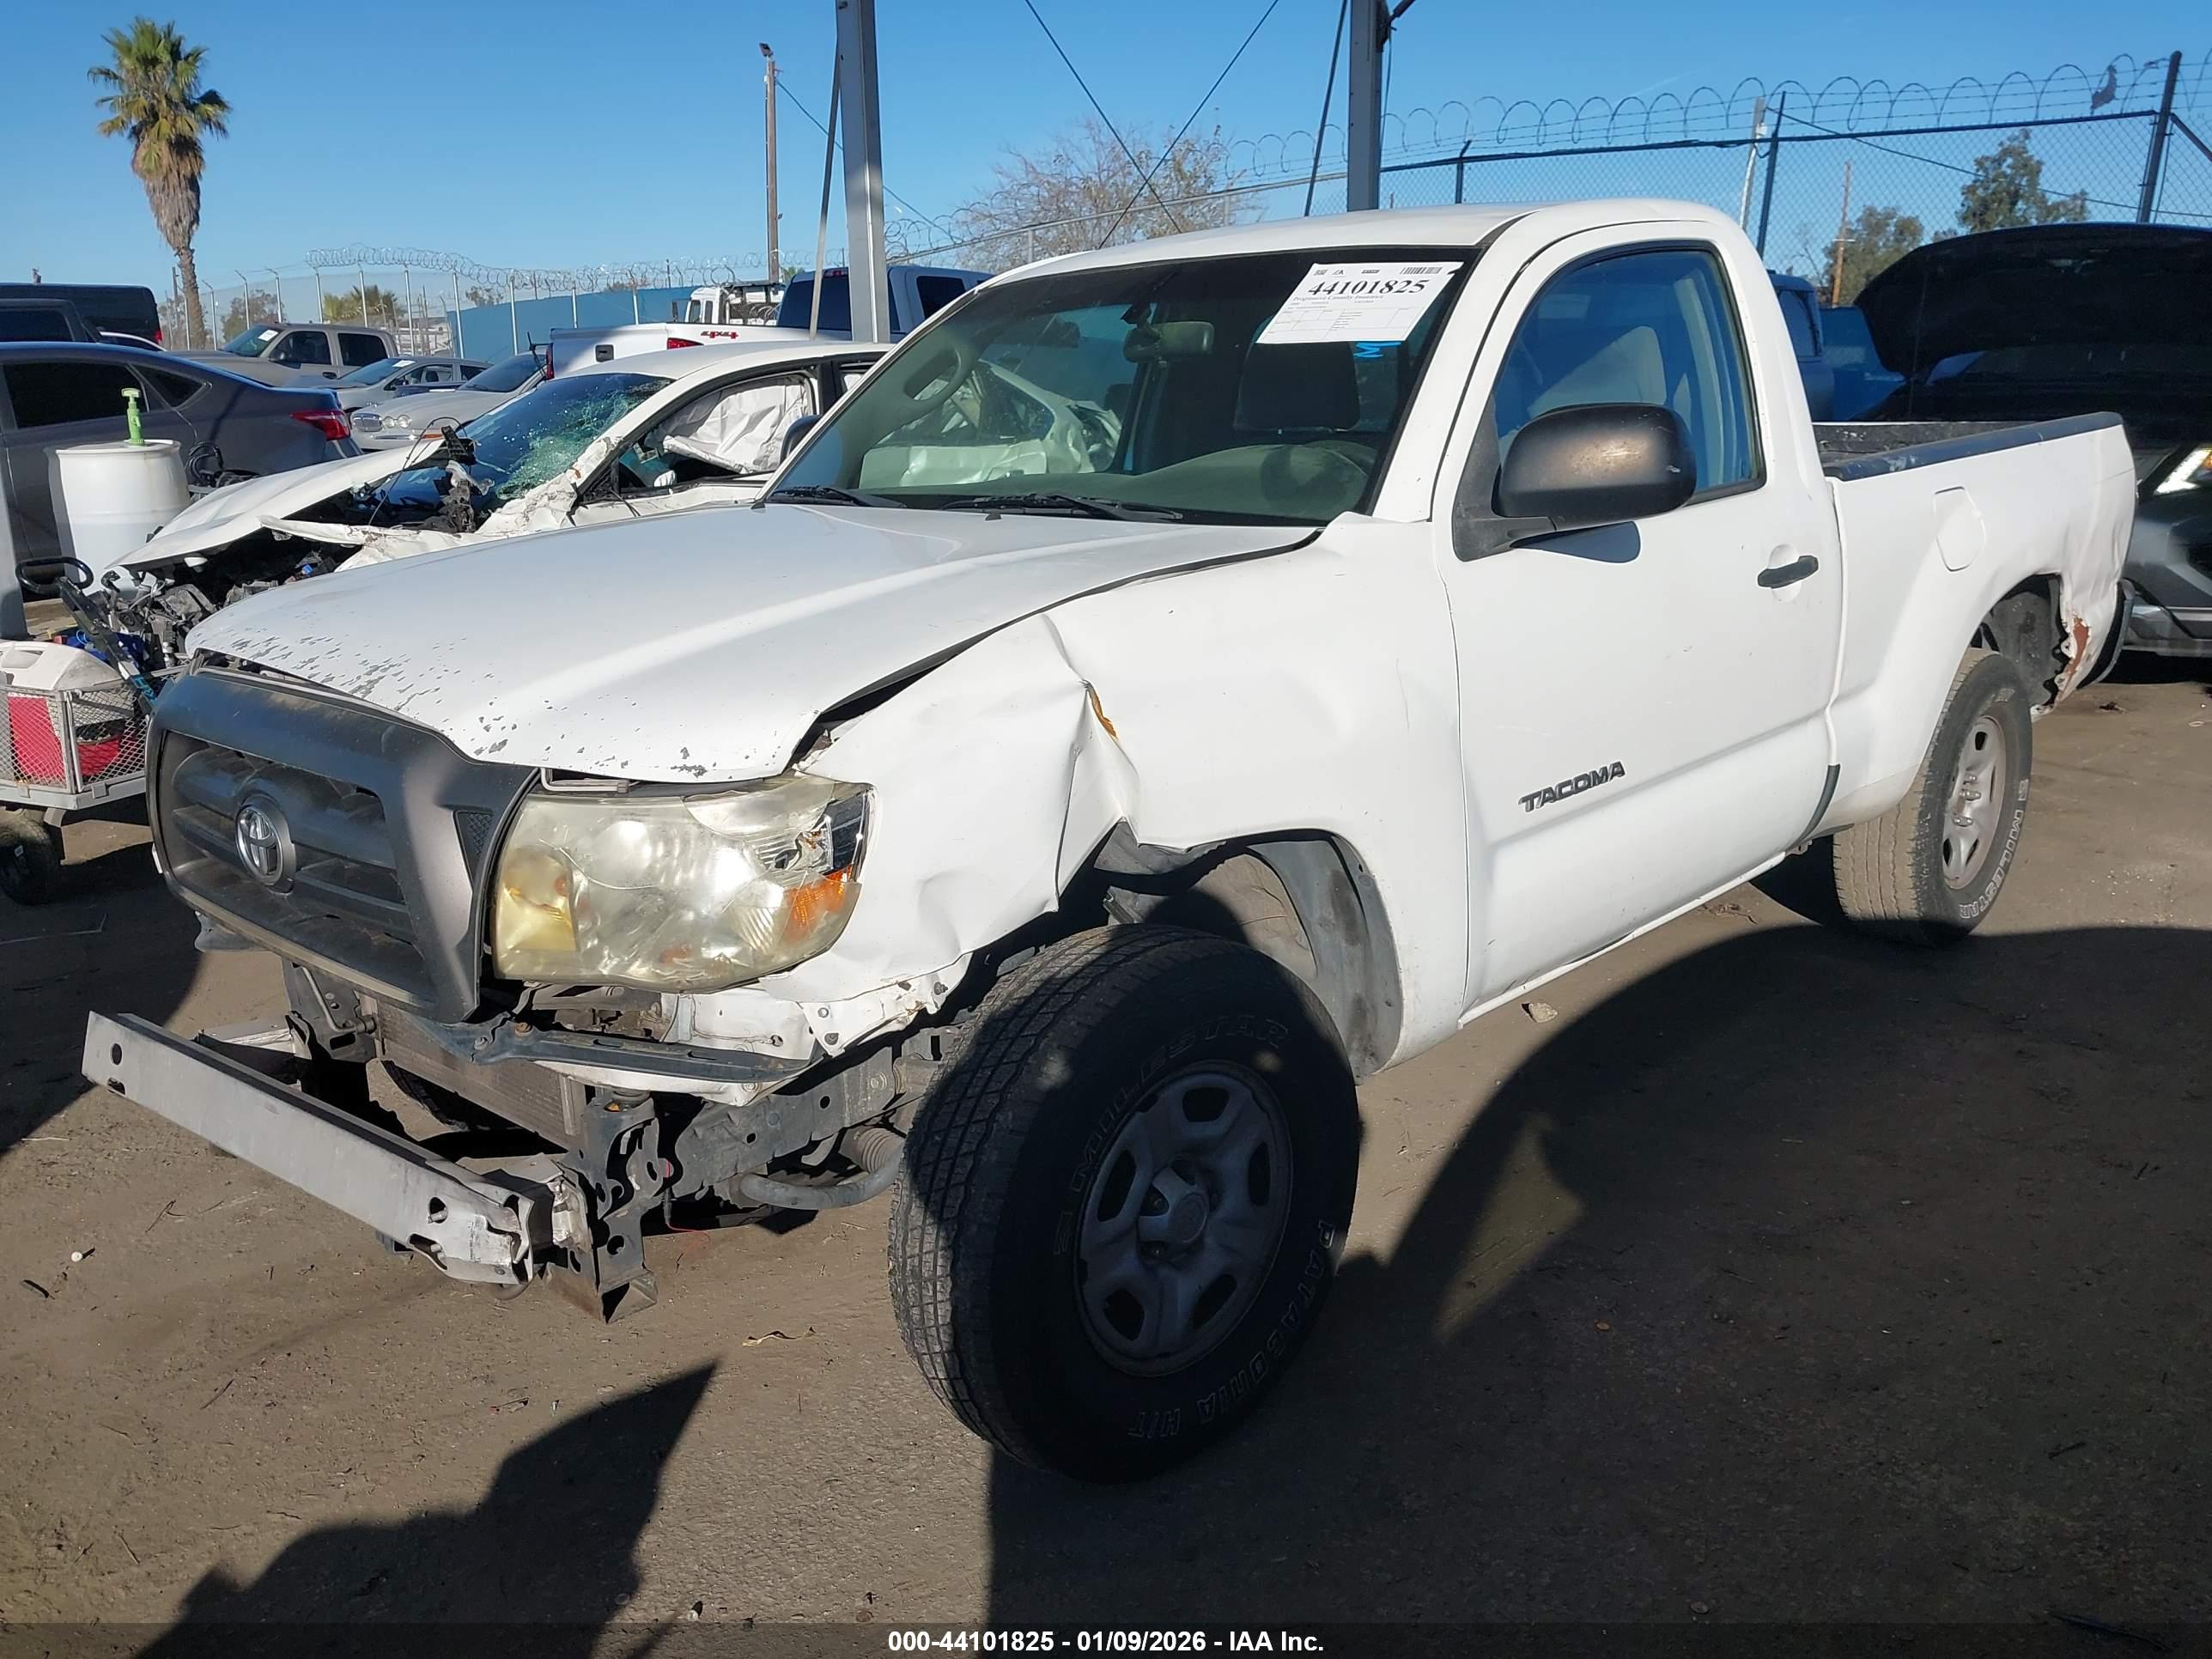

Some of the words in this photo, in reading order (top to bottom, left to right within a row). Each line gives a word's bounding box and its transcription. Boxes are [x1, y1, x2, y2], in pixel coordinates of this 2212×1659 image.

[1308, 279, 1431, 295] 44101825
[1518, 761, 1626, 812] TACOMA
[1959, 810, 2024, 919] MILESTAR
[1070, 1014, 1291, 1194] MILESTAR
[1195, 1219, 1337, 1426] PATAGONIA
